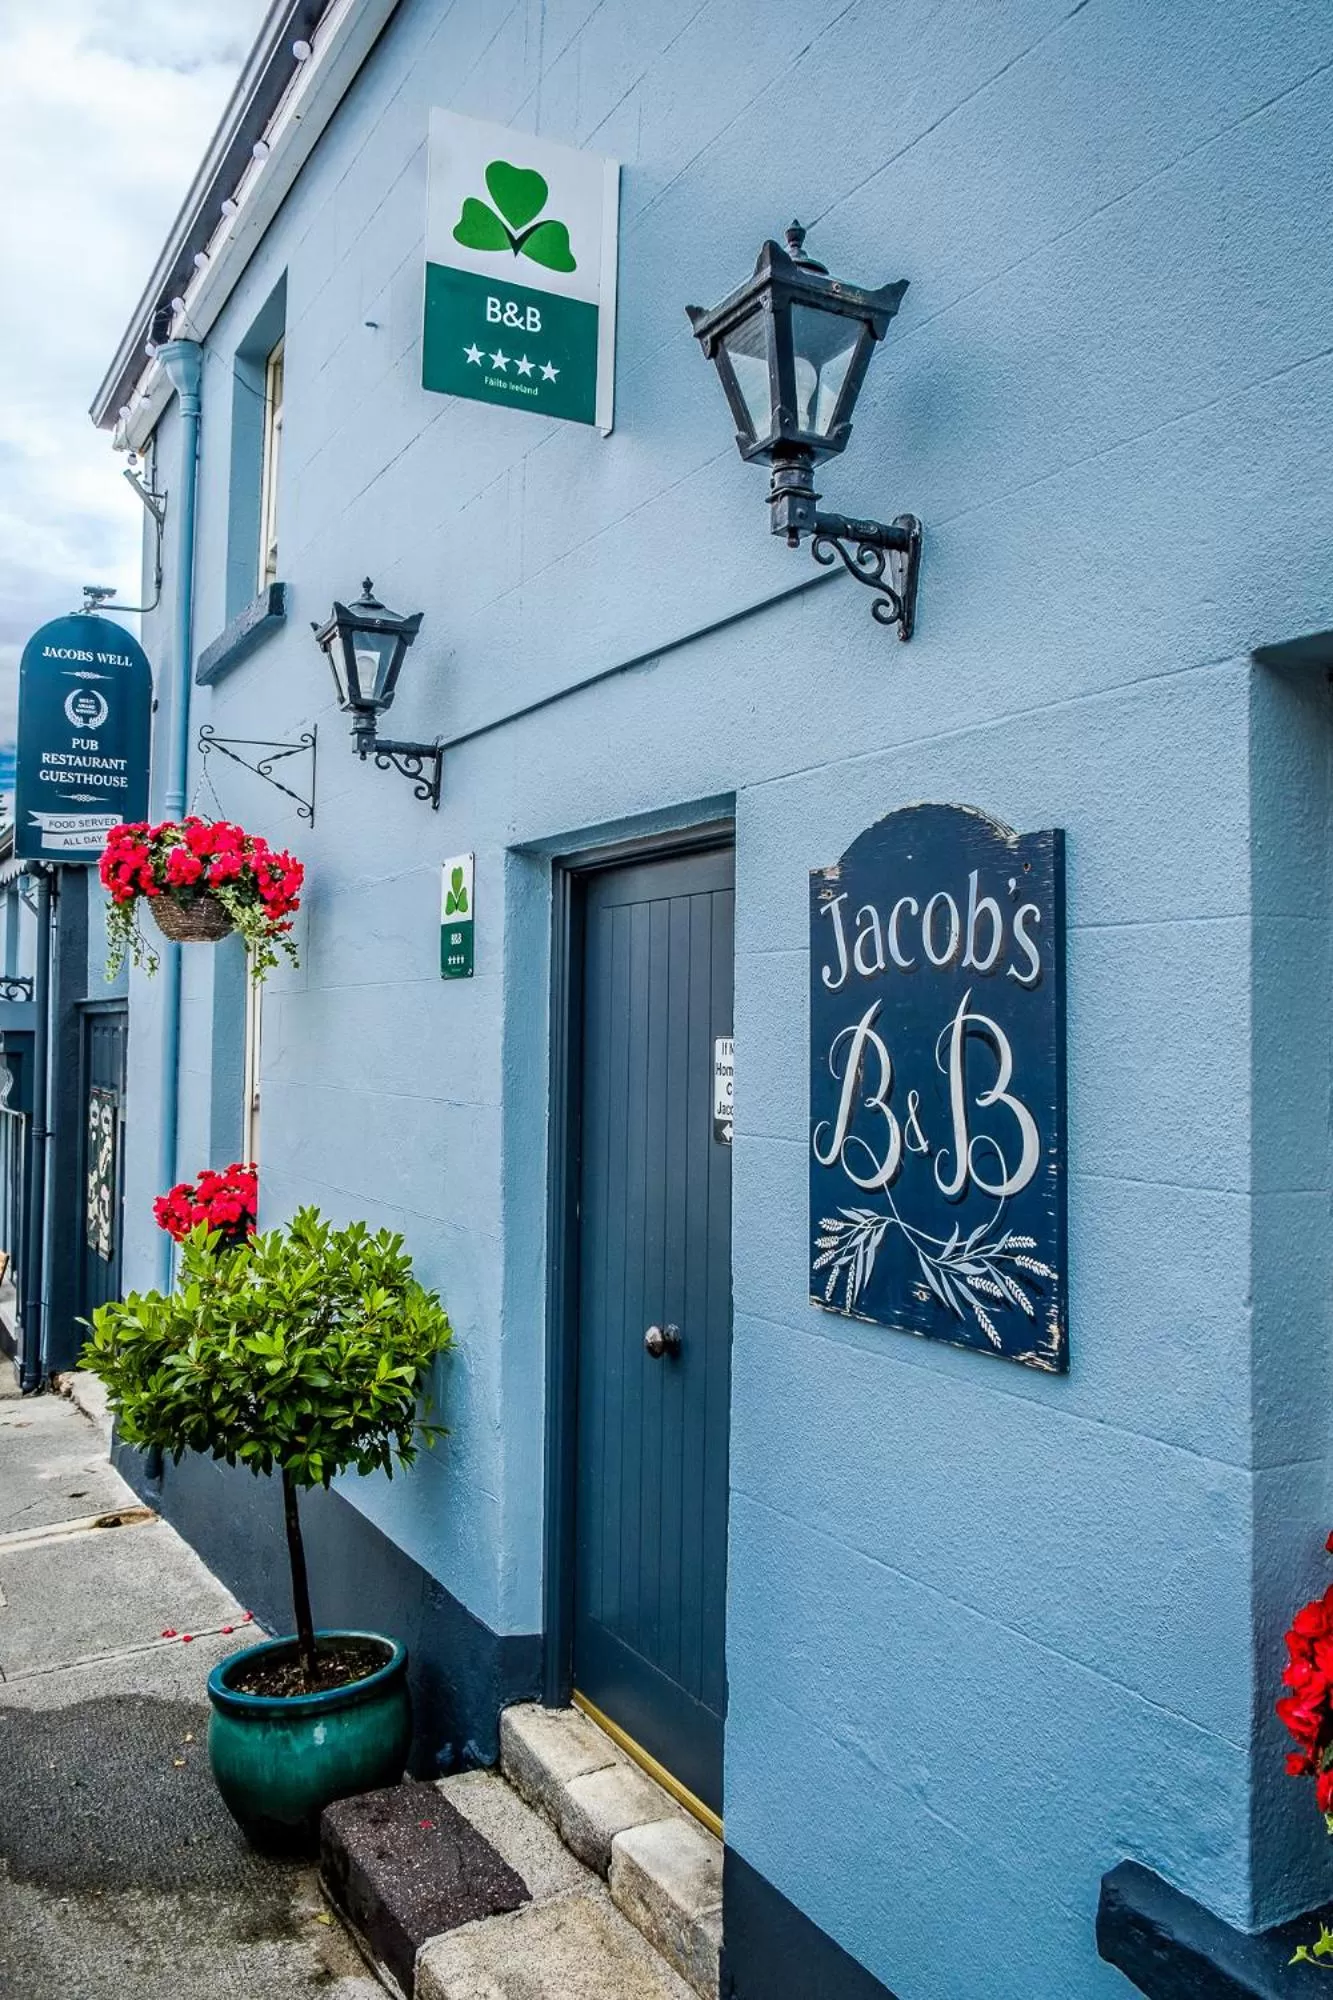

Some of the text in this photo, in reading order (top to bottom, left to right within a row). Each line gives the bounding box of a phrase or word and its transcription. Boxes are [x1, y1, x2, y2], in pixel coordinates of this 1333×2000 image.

[486, 296, 542, 333] B&B
[509, 382, 538, 396] Ireland
[42, 646, 132, 667] JACOBS WELL
[72, 738, 99, 751] PUB
[42, 753, 127, 771] RESTAURANT
[40, 770, 128, 788] GUESTHOUSE
[49, 818, 117, 829] FOOD SERVED
[63, 835, 102, 846] ALL DAY
[820, 869, 1042, 989] Jacob's
[715, 1062, 734, 1076] Hom
[726, 1082, 733, 1096] C
